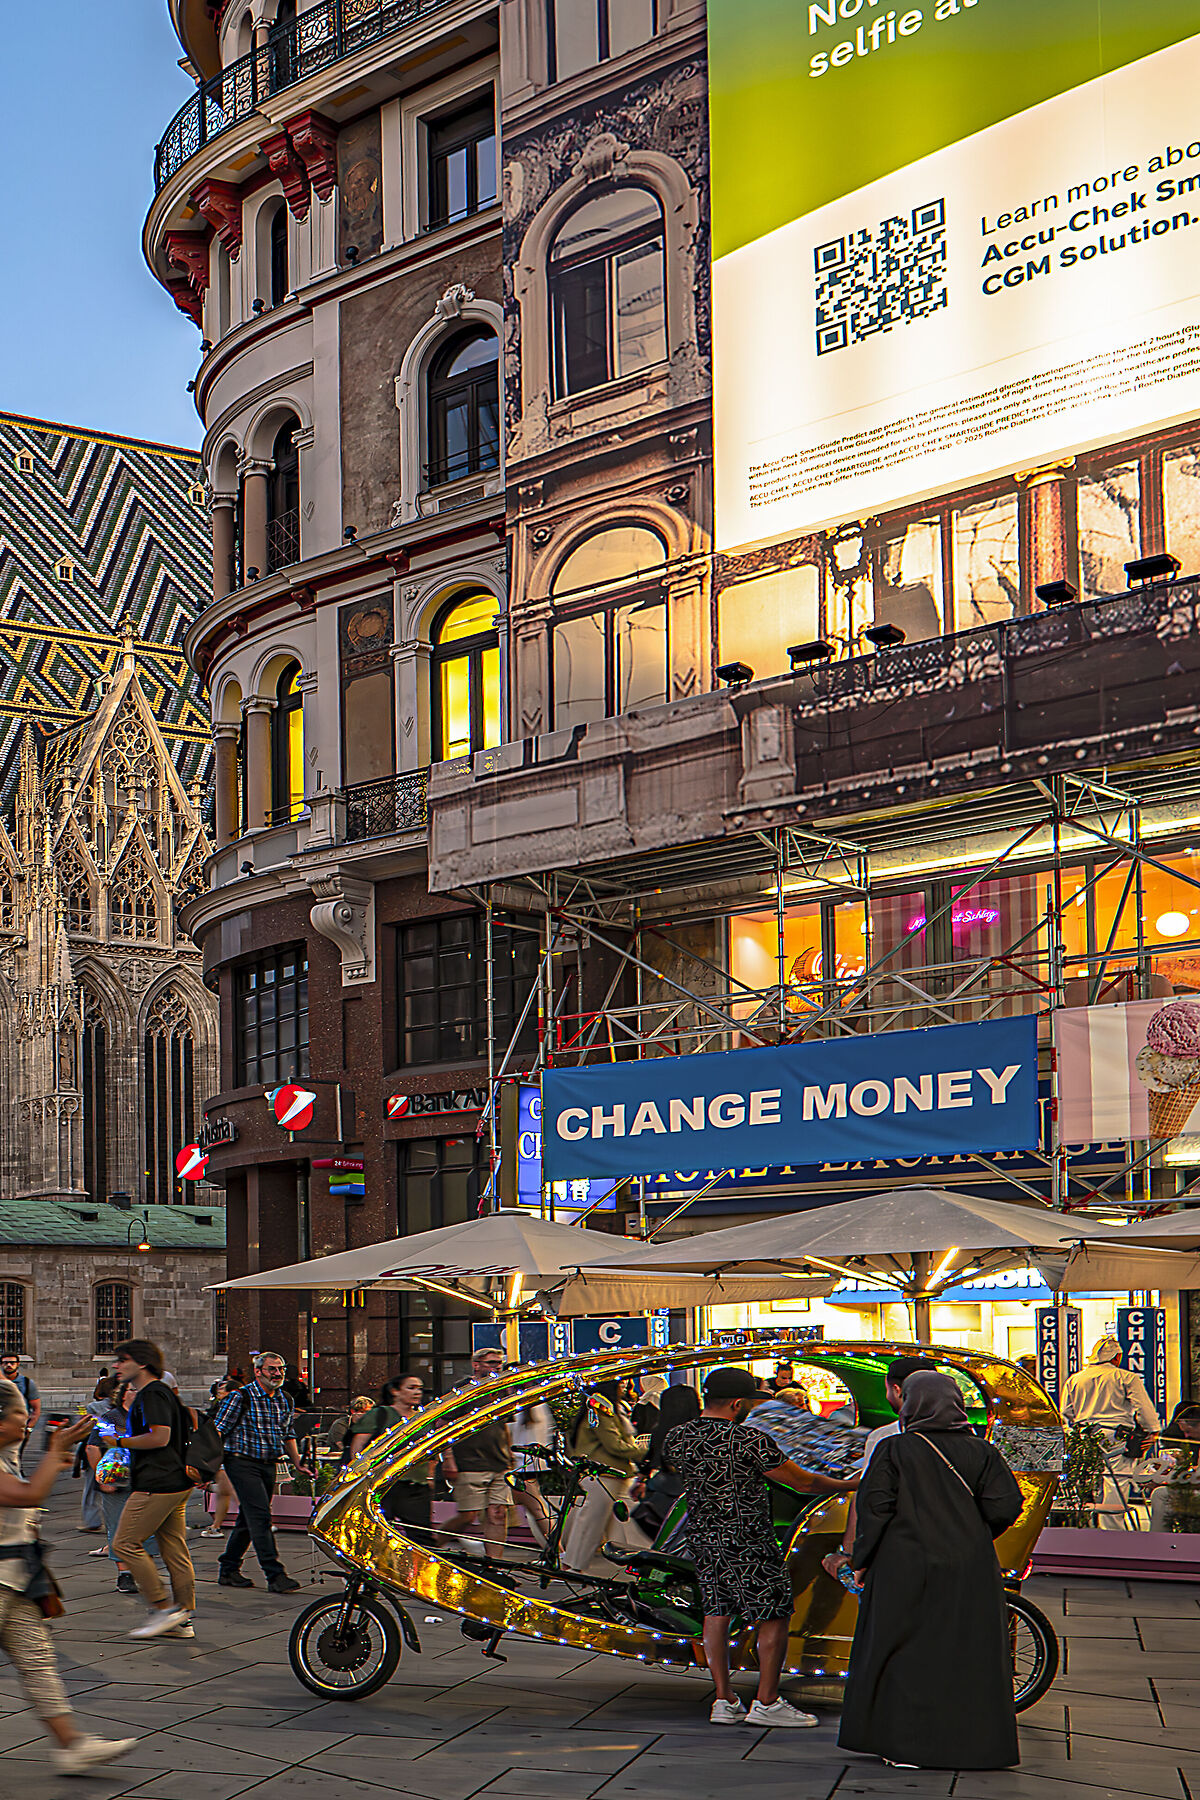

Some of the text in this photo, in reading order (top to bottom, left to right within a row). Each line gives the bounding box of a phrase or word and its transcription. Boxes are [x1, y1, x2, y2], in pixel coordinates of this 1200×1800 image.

[808, 0, 880, 36] No
[808, 9, 923, 78] selfie
[981, 194, 1058, 236] Learn
[1067, 165, 1139, 203] more
[981, 191, 1148, 268] Accu-Chek
[981, 211, 1199, 296] CGM Solution.
[748, 470, 768, 480] within
[783, 460, 797, 469] next
[809, 449, 836, 461] minutes
[837, 444, 854, 453] (Low
[855, 434, 884, 447] Glucose
[918, 417, 931, 426] and
[947, 400, 984, 417] estimated
[986, 395, 999, 404] risk
[1002, 391, 1010, 399] of
[1143, 338, 1184, 354] upcoming
[749, 483, 762, 491] This
[763, 473, 790, 487] product
[804, 461, 831, 473] medical
[832, 454, 856, 465] device
[858, 442, 889, 457] intended
[961, 413, 986, 425] please
[988, 407, 1002, 415] use
[1004, 402, 1020, 410] only
[1032, 385, 1066, 400] directed
[1069, 380, 1083, 388] and
[1124, 355, 1170, 372] healthcare
[800, 440, 840, 456] SmartGuide
[842, 431, 867, 443] Predict
[868, 427, 882, 435] app
[884, 416, 913, 431] predicts
[930, 401, 958, 415] general
[959, 388, 997, 405] estimated
[999, 379, 1030, 393] glucose
[1032, 359, 1083, 381] development
[1086, 352, 1110, 363] within
[1128, 340, 1146, 350] next
[1156, 332, 1180, 342] hours
[835, 457, 881, 475] SMARTGUIDE
[883, 451, 897, 460] and
[944, 422, 994, 440] SMARTGUIDE
[996, 409, 1029, 425] PREDICT
[1031, 405, 1044, 413] are
[1046, 390, 1093, 408] trademarks
[1148, 368, 1170, 377] other
[763, 494, 788, 504] screens
[791, 489, 803, 497] you
[818, 480, 832, 488] may
[833, 474, 852, 483] differ
[854, 468, 870, 477] from
[886, 454, 914, 467] screens
[964, 433, 983, 443] 2025
[984, 425, 1008, 436] Roche
[1010, 413, 1045, 428] Diabetes
[1138, 378, 1164, 388] Roche
[962, 909, 999, 923] Schlag
[411, 1090, 460, 1114] Bank
[556, 1088, 783, 1142] CHANGE
[802, 1064, 1022, 1122] MONEY
[1042, 1315, 1056, 1393] CHANGE
[1156, 1311, 1165, 1403] CHANGE
